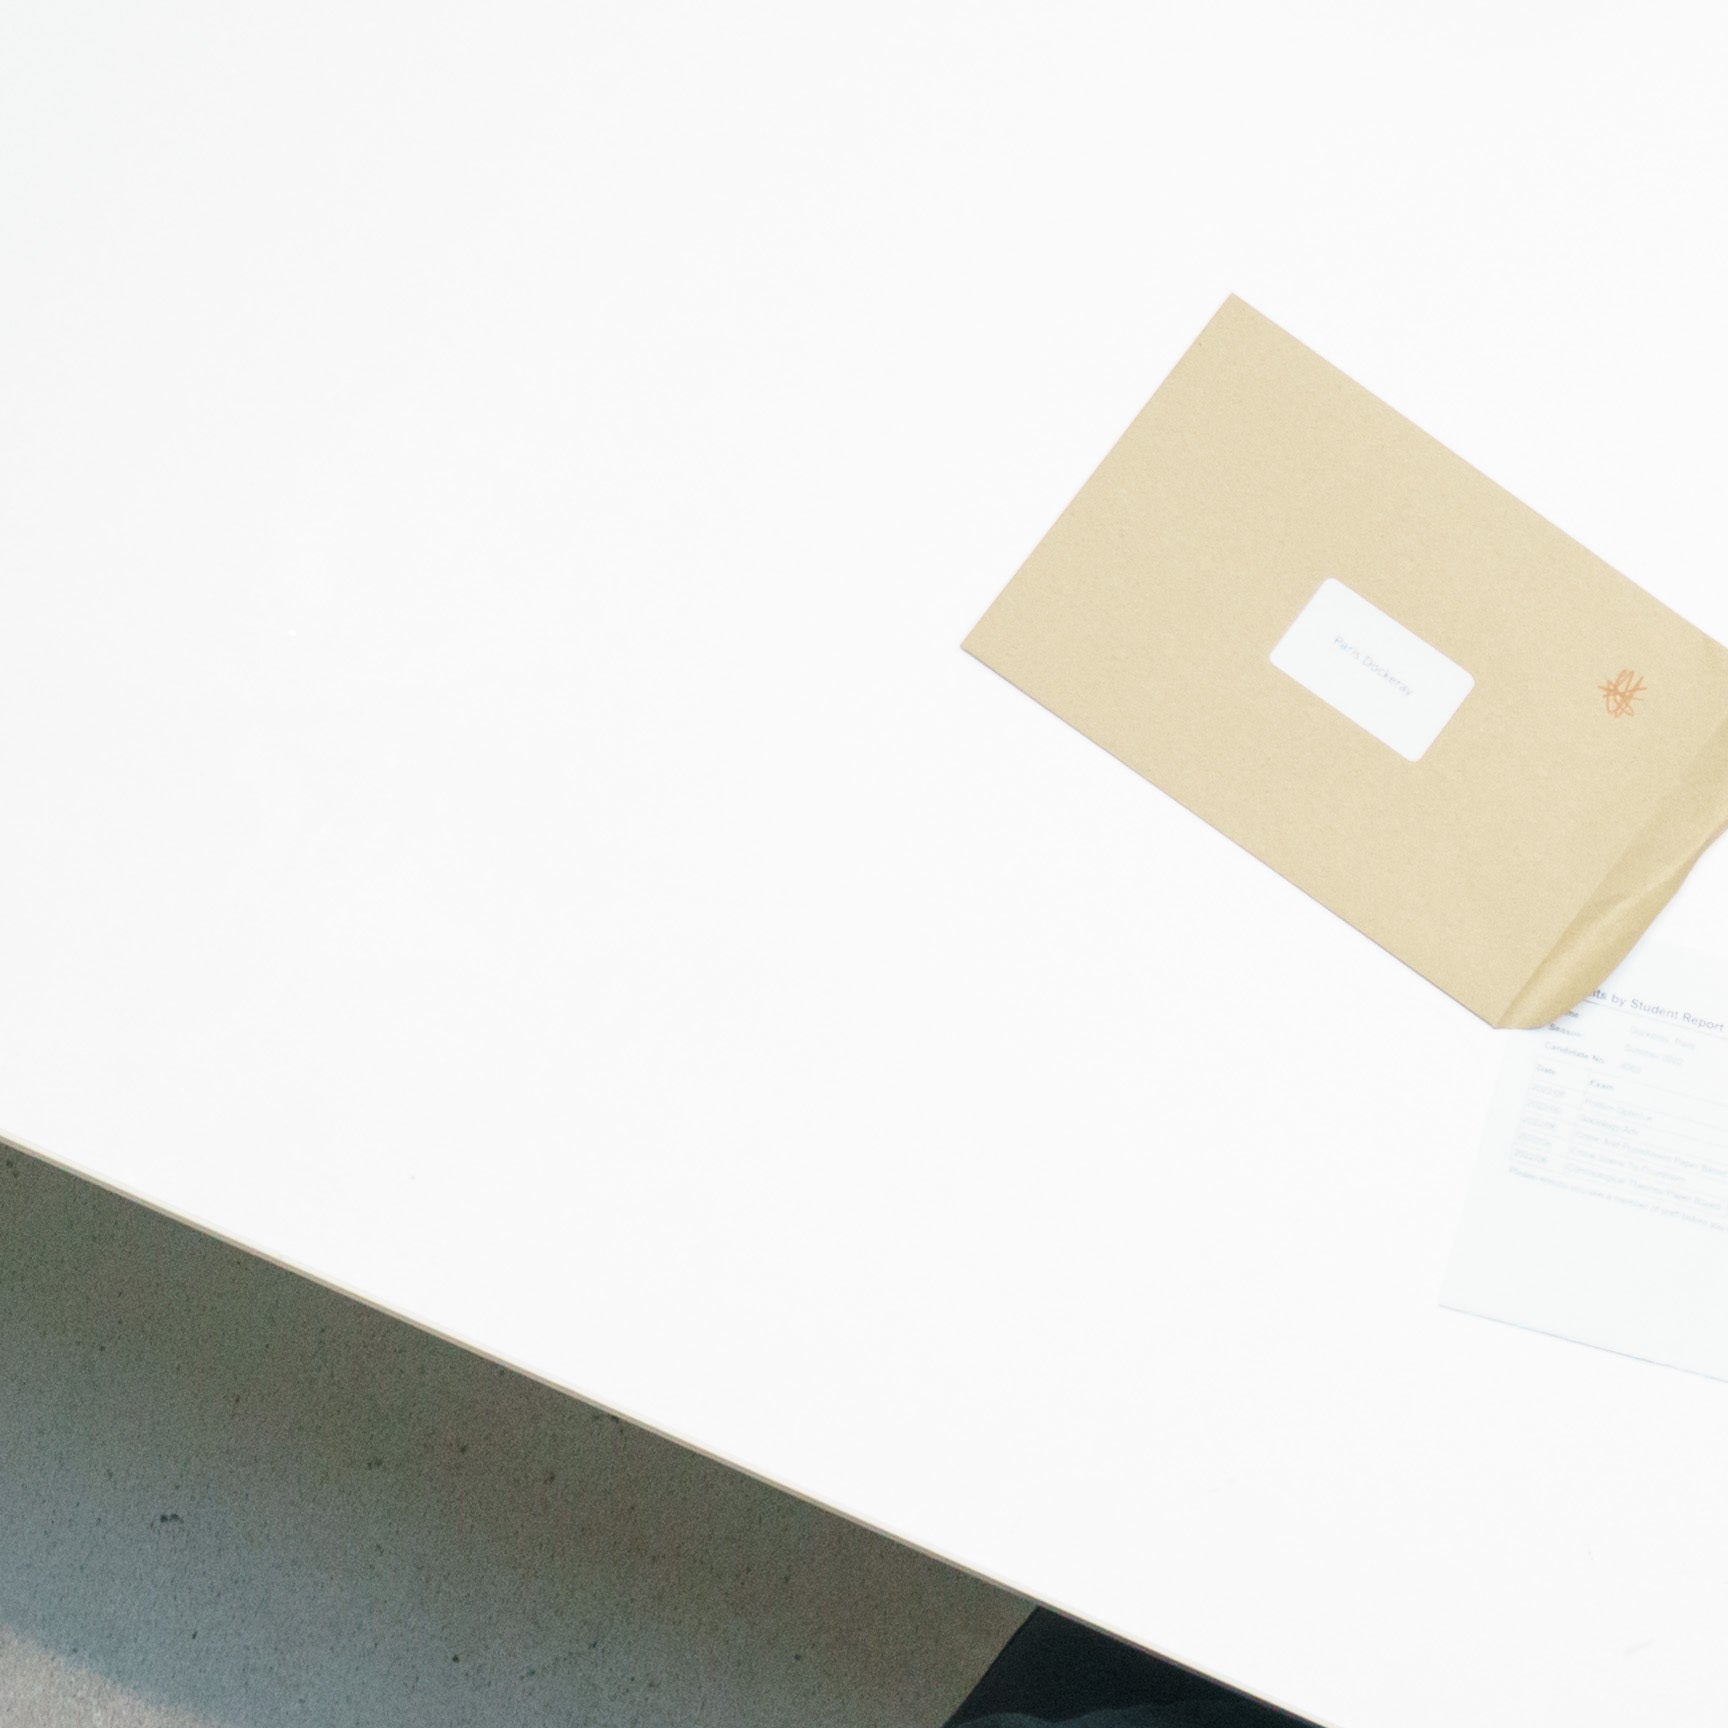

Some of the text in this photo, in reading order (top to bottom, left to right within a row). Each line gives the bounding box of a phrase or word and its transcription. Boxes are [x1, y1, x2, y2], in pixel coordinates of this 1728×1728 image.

[1332, 635, 1363, 660] Paris
[1611, 994, 1627, 1007] by
[1630, 999, 1678, 1019] Student
[1681, 1013, 1724, 1033] Report
